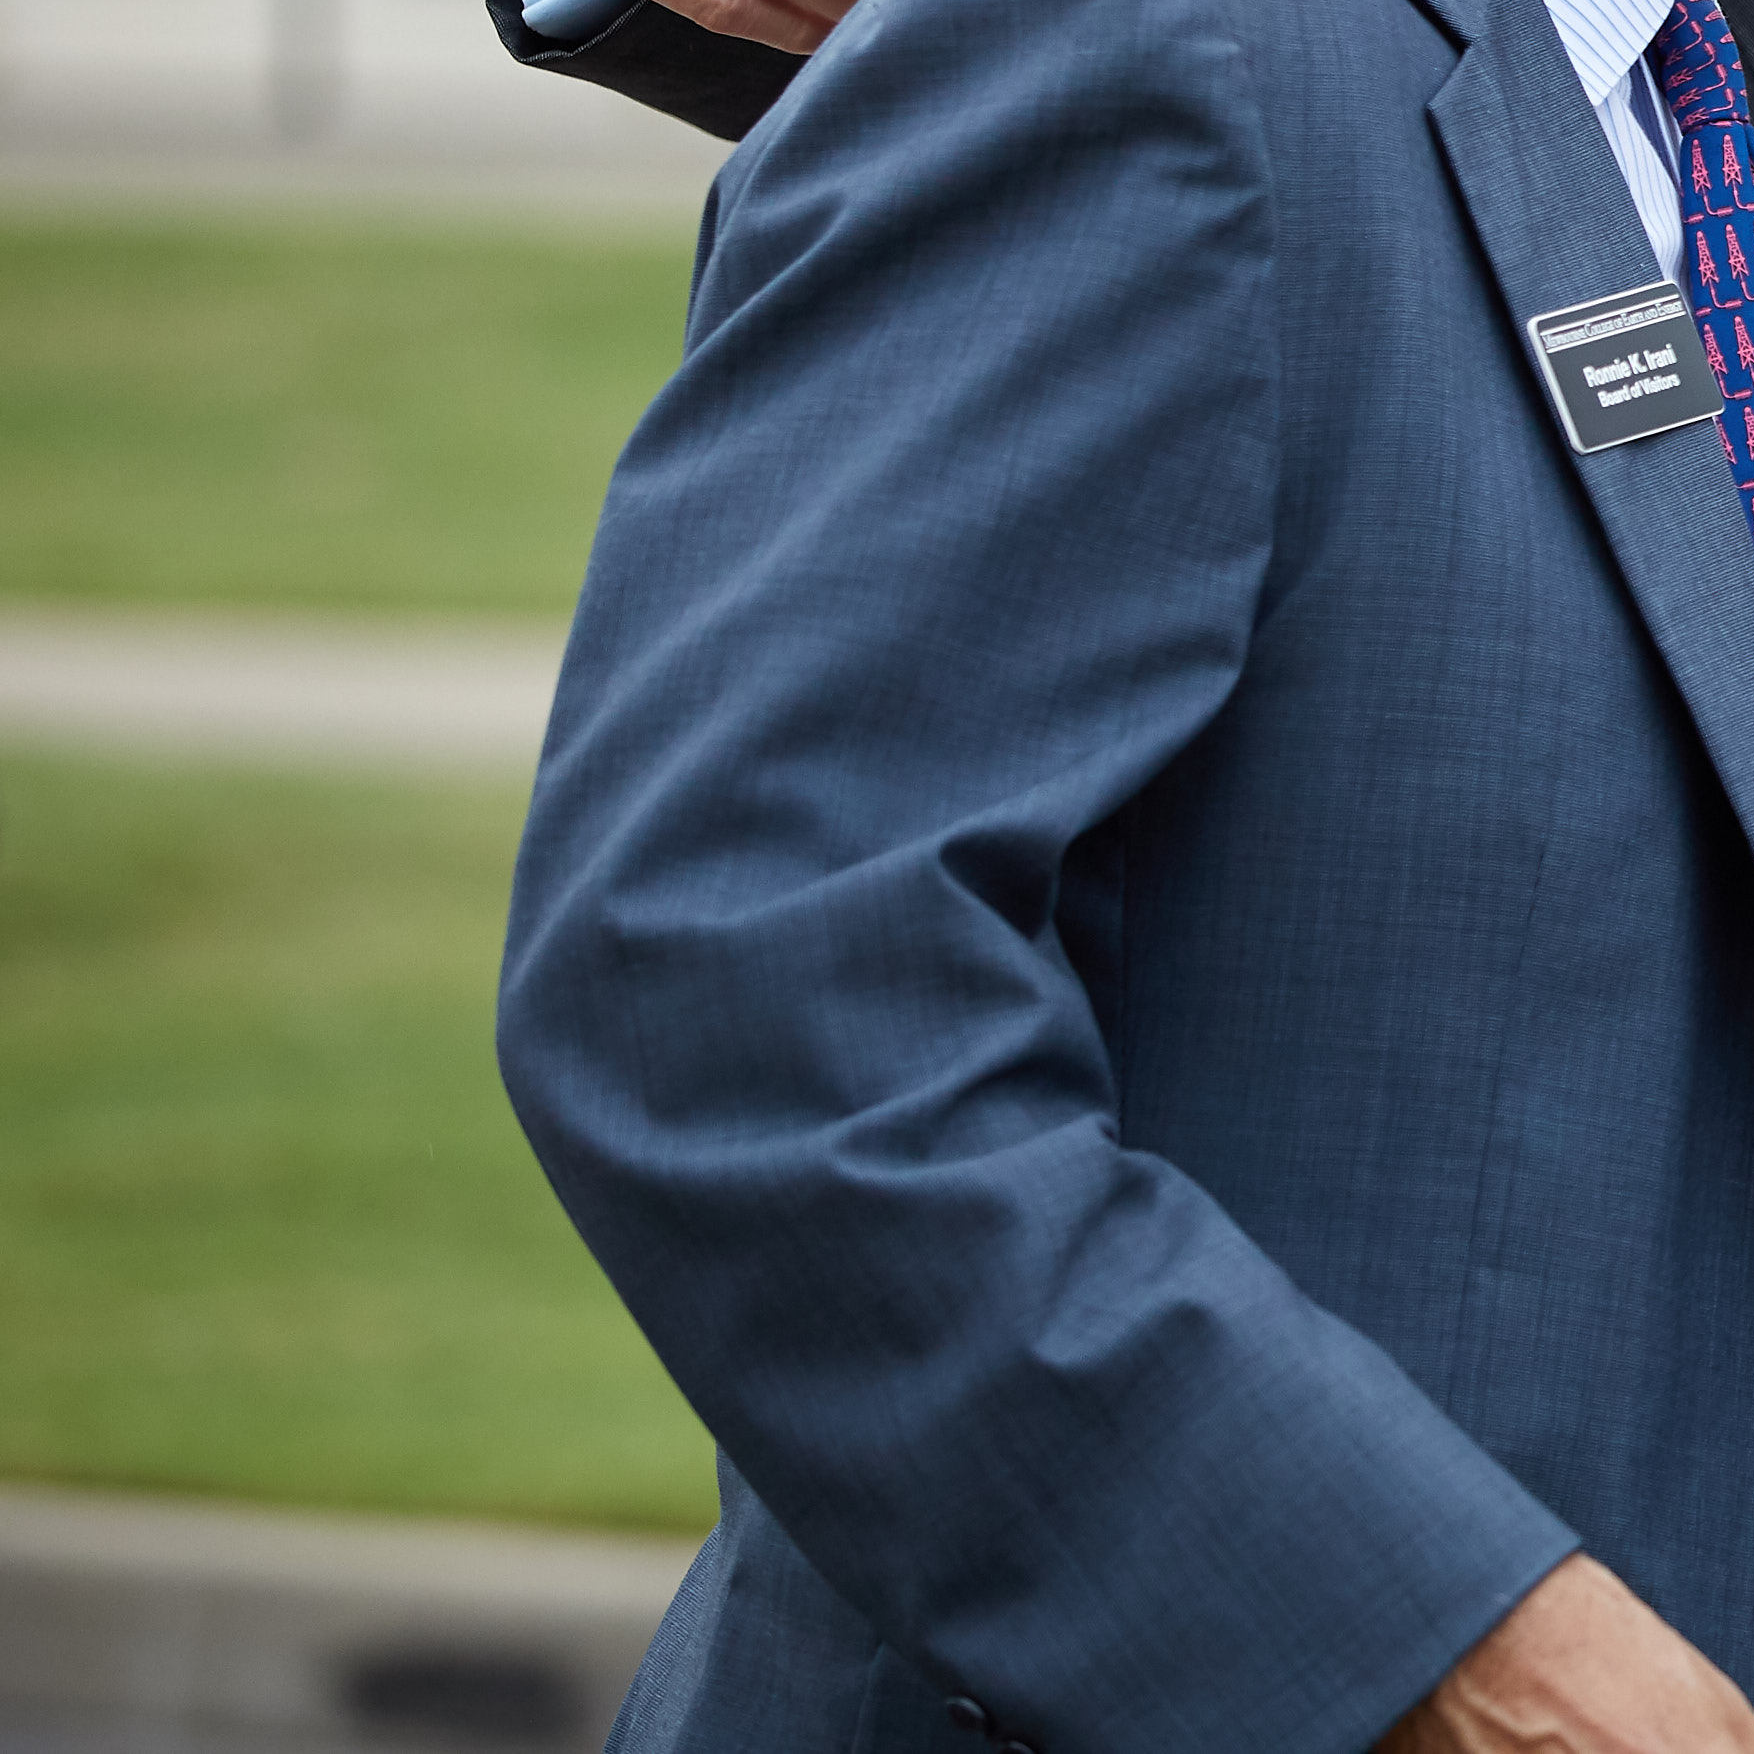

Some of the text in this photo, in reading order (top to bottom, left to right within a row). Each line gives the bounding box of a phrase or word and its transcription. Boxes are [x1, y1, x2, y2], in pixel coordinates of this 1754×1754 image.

[1583, 343, 1678, 388] Ronnie K. Irani
[1597, 374, 1681, 408] Board of Visitors
